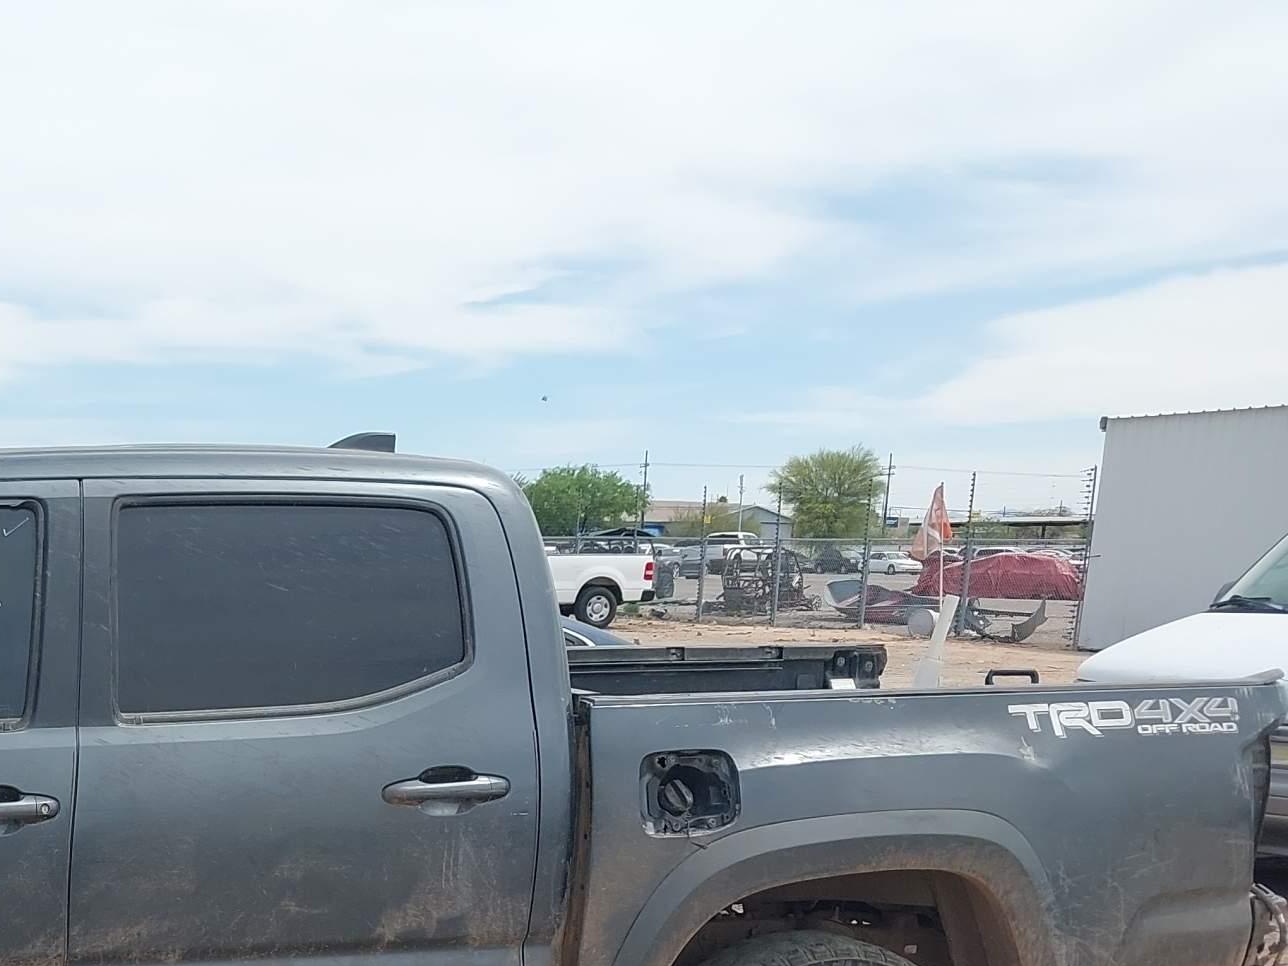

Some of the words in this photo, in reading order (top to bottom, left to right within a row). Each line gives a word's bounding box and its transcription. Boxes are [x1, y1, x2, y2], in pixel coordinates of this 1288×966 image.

[1007, 699, 1136, 739] TRD
[1137, 723, 1180, 736] OFF
[1181, 722, 1239, 735] ROAD
